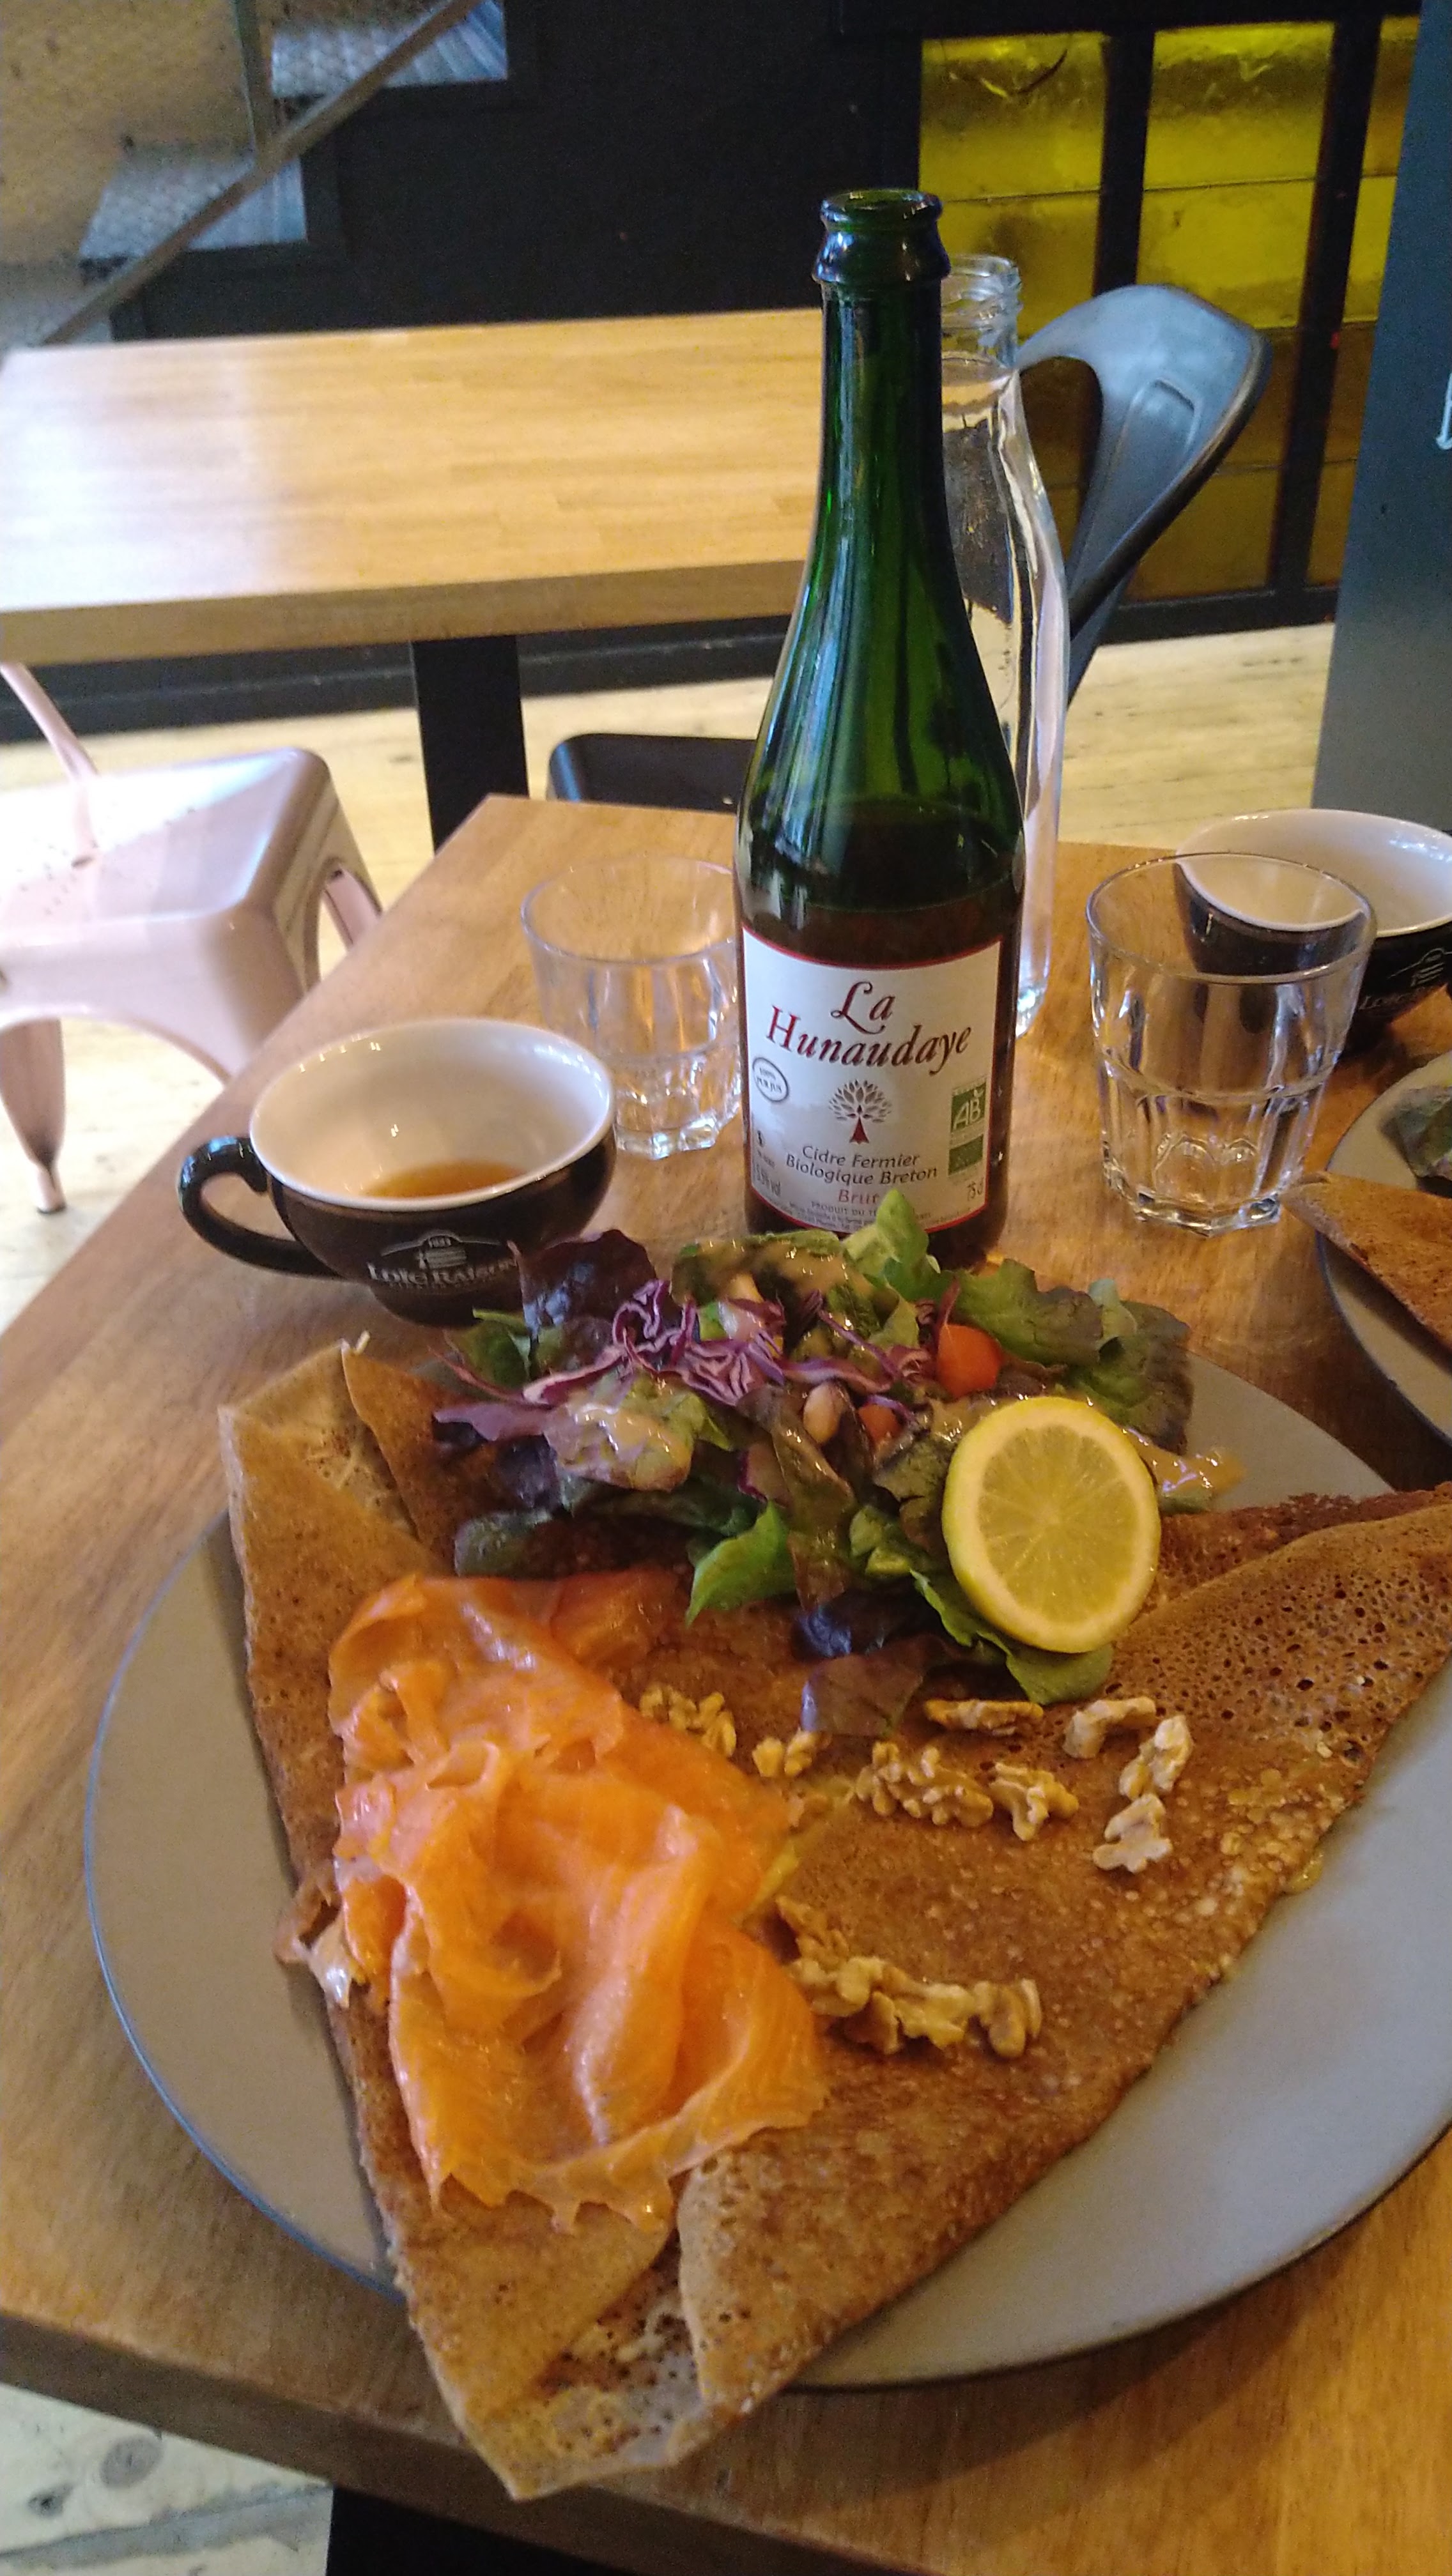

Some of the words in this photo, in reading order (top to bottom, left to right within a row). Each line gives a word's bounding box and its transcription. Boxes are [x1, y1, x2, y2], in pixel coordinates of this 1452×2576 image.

[831, 981, 896, 1034] La
[766, 1005, 971, 1076] Hunaudaye
[953, 1098, 982, 1130] AB
[785, 1153, 874, 1186] Biologique
[879, 1167, 938, 1185] Breton
[802, 1146, 846, 1167] Cidre
[852, 1153, 920, 1169] Fermier
[838, 1189, 880, 1204] Brut
